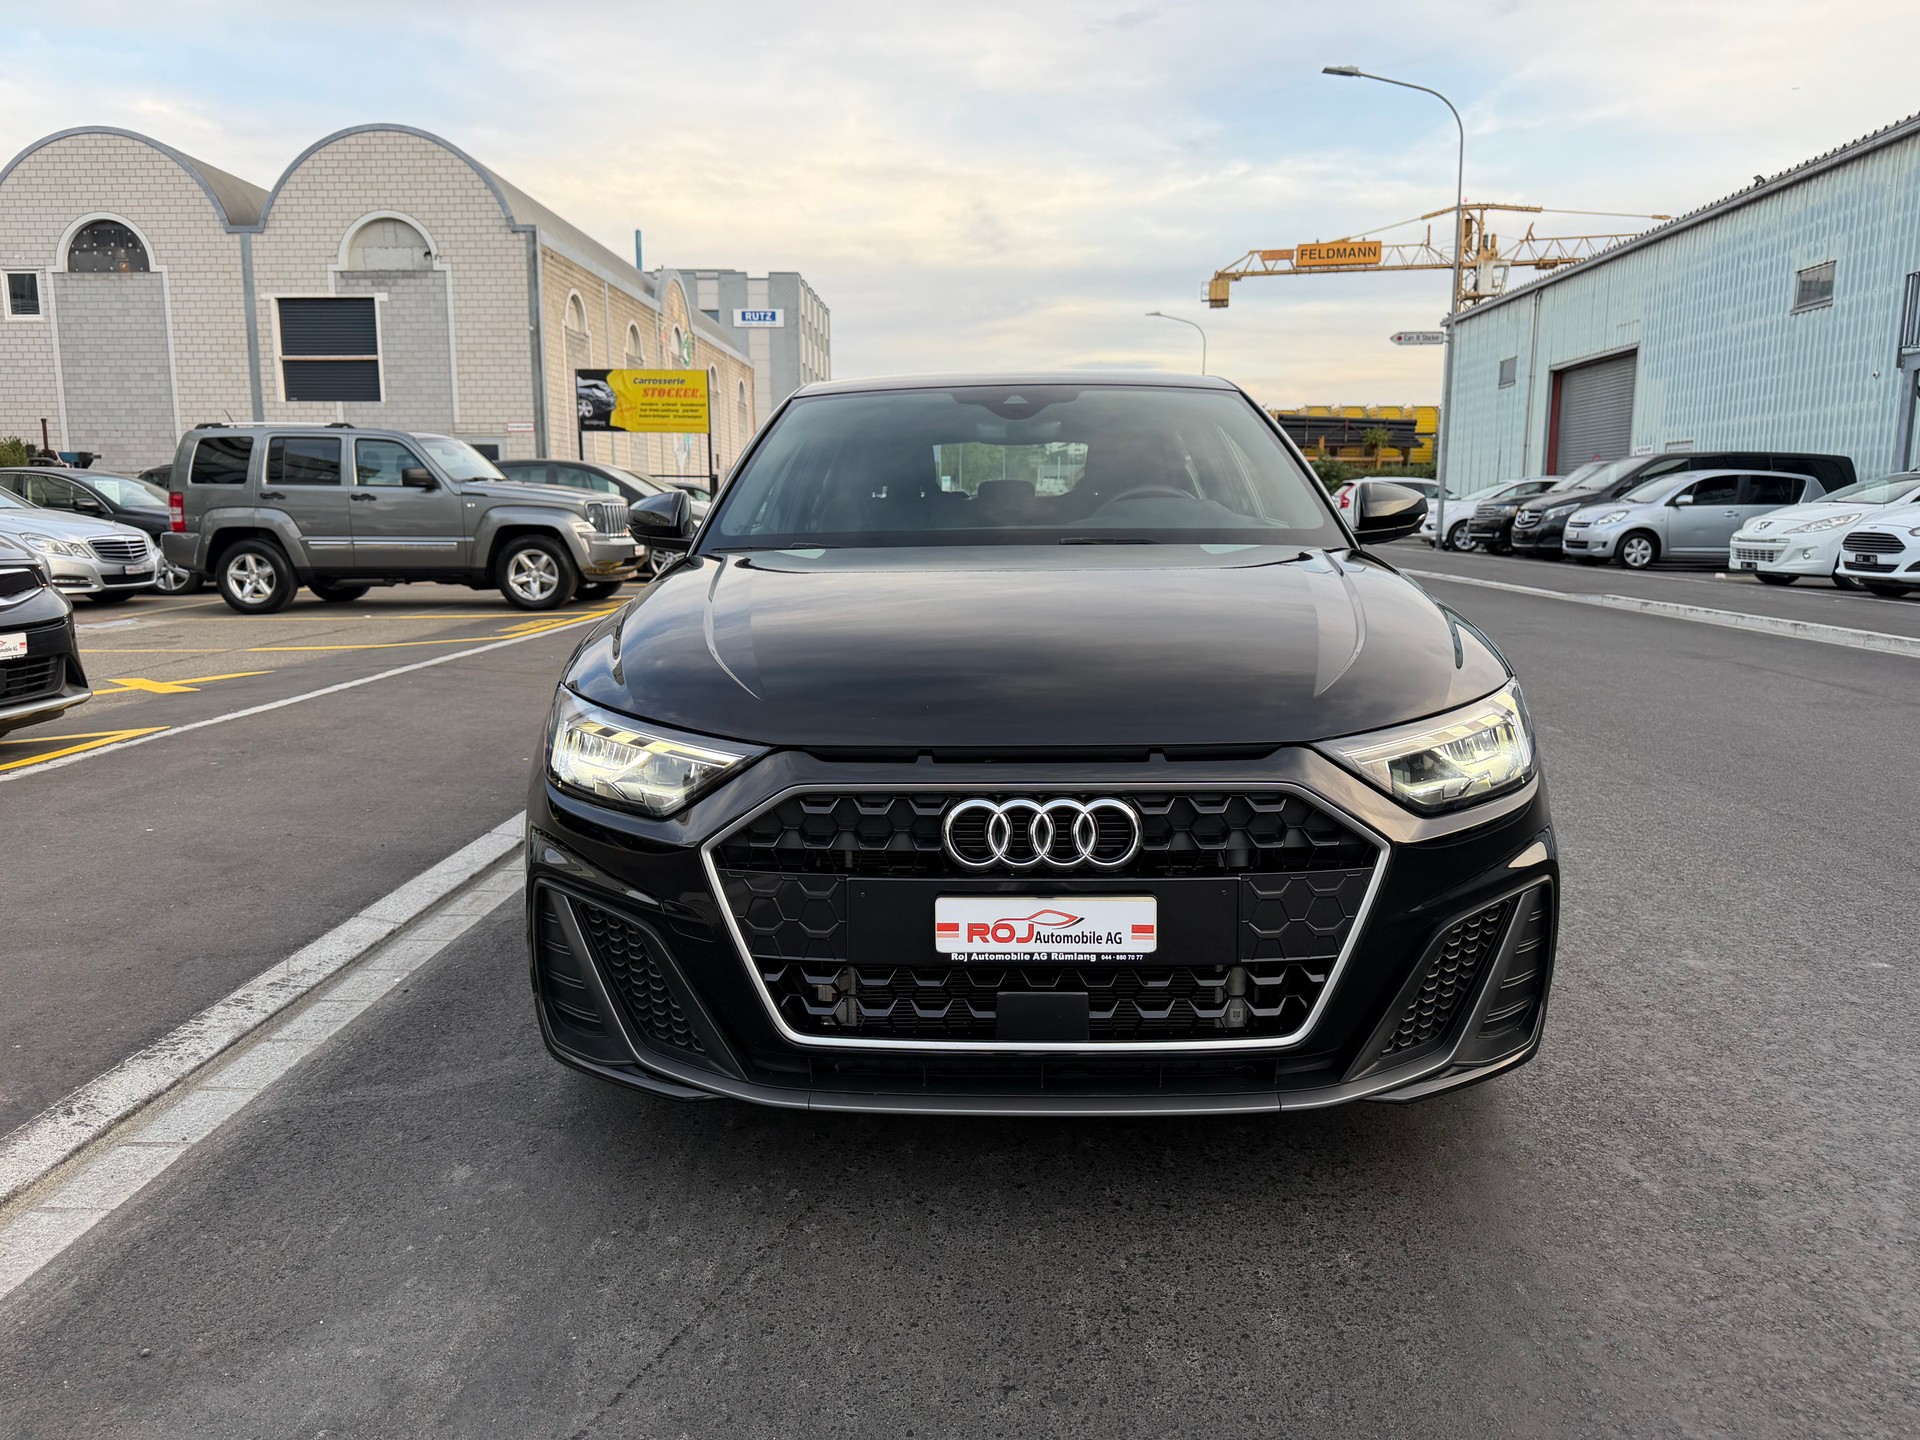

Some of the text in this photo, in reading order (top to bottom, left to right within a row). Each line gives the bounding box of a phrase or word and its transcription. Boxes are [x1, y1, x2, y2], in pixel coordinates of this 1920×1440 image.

[1300, 247, 1377, 260] FELDMANN
[745, 312, 773, 321] RUTZ
[633, 377, 686, 385] Carrosserie
[642, 387, 700, 399] STOCKER
[967, 922, 1035, 944] ROJ
[1034, 930, 1123, 945] Automobile AG
[951, 952, 968, 962] Roj
[971, 952, 1030, 961] Automobile
[1032, 952, 1048, 961] AG
[1051, 951, 1097, 962] Rümlang
